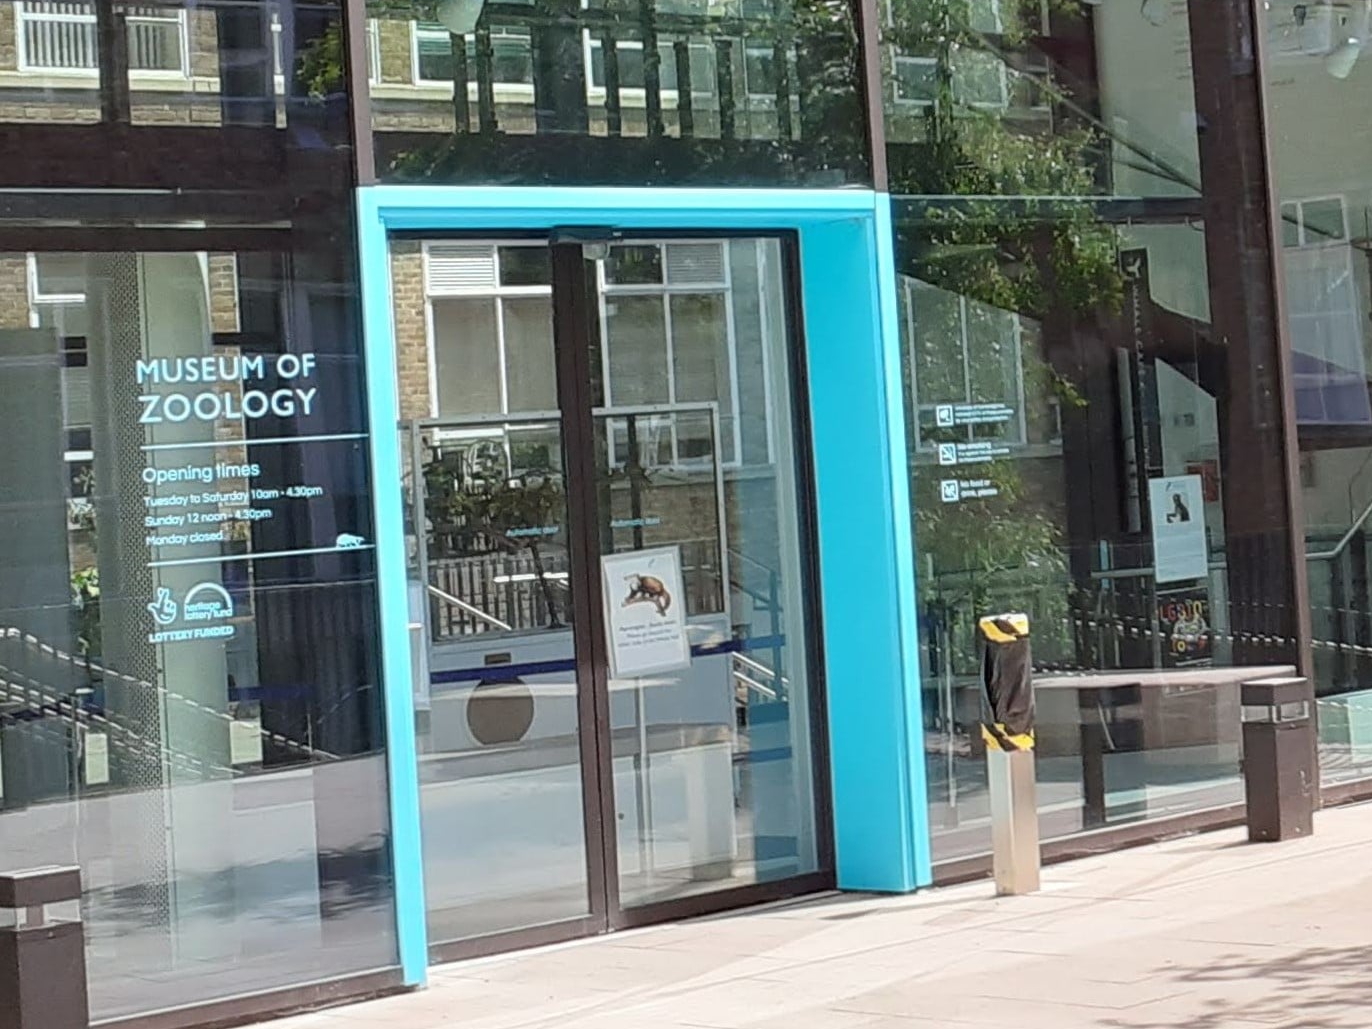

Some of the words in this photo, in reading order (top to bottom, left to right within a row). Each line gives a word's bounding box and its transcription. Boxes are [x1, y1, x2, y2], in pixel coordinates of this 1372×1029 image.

[136, 355, 265, 384] MUSEUM
[276, 353, 316, 379] OF
[138, 387, 317, 423] ZOOLOGY
[142, 466, 213, 485] Opening
[216, 463, 261, 479] times
[143, 493, 189, 507] Tuesday
[190, 493, 200, 504] to
[202, 490, 249, 504] Saturday
[251, 488, 278, 500] 10am
[286, 486, 323, 499] 4.30pm
[144, 513, 185, 527] Sunday
[187, 512, 199, 523] 12
[201, 512, 227, 522] noon
[235, 508, 273, 521] 4.30pm
[146, 532, 188, 546] Monday
[213, 607, 233, 618] fund
[149, 630, 193, 643] LOTTERY
[194, 625, 235, 639] FUNDED
